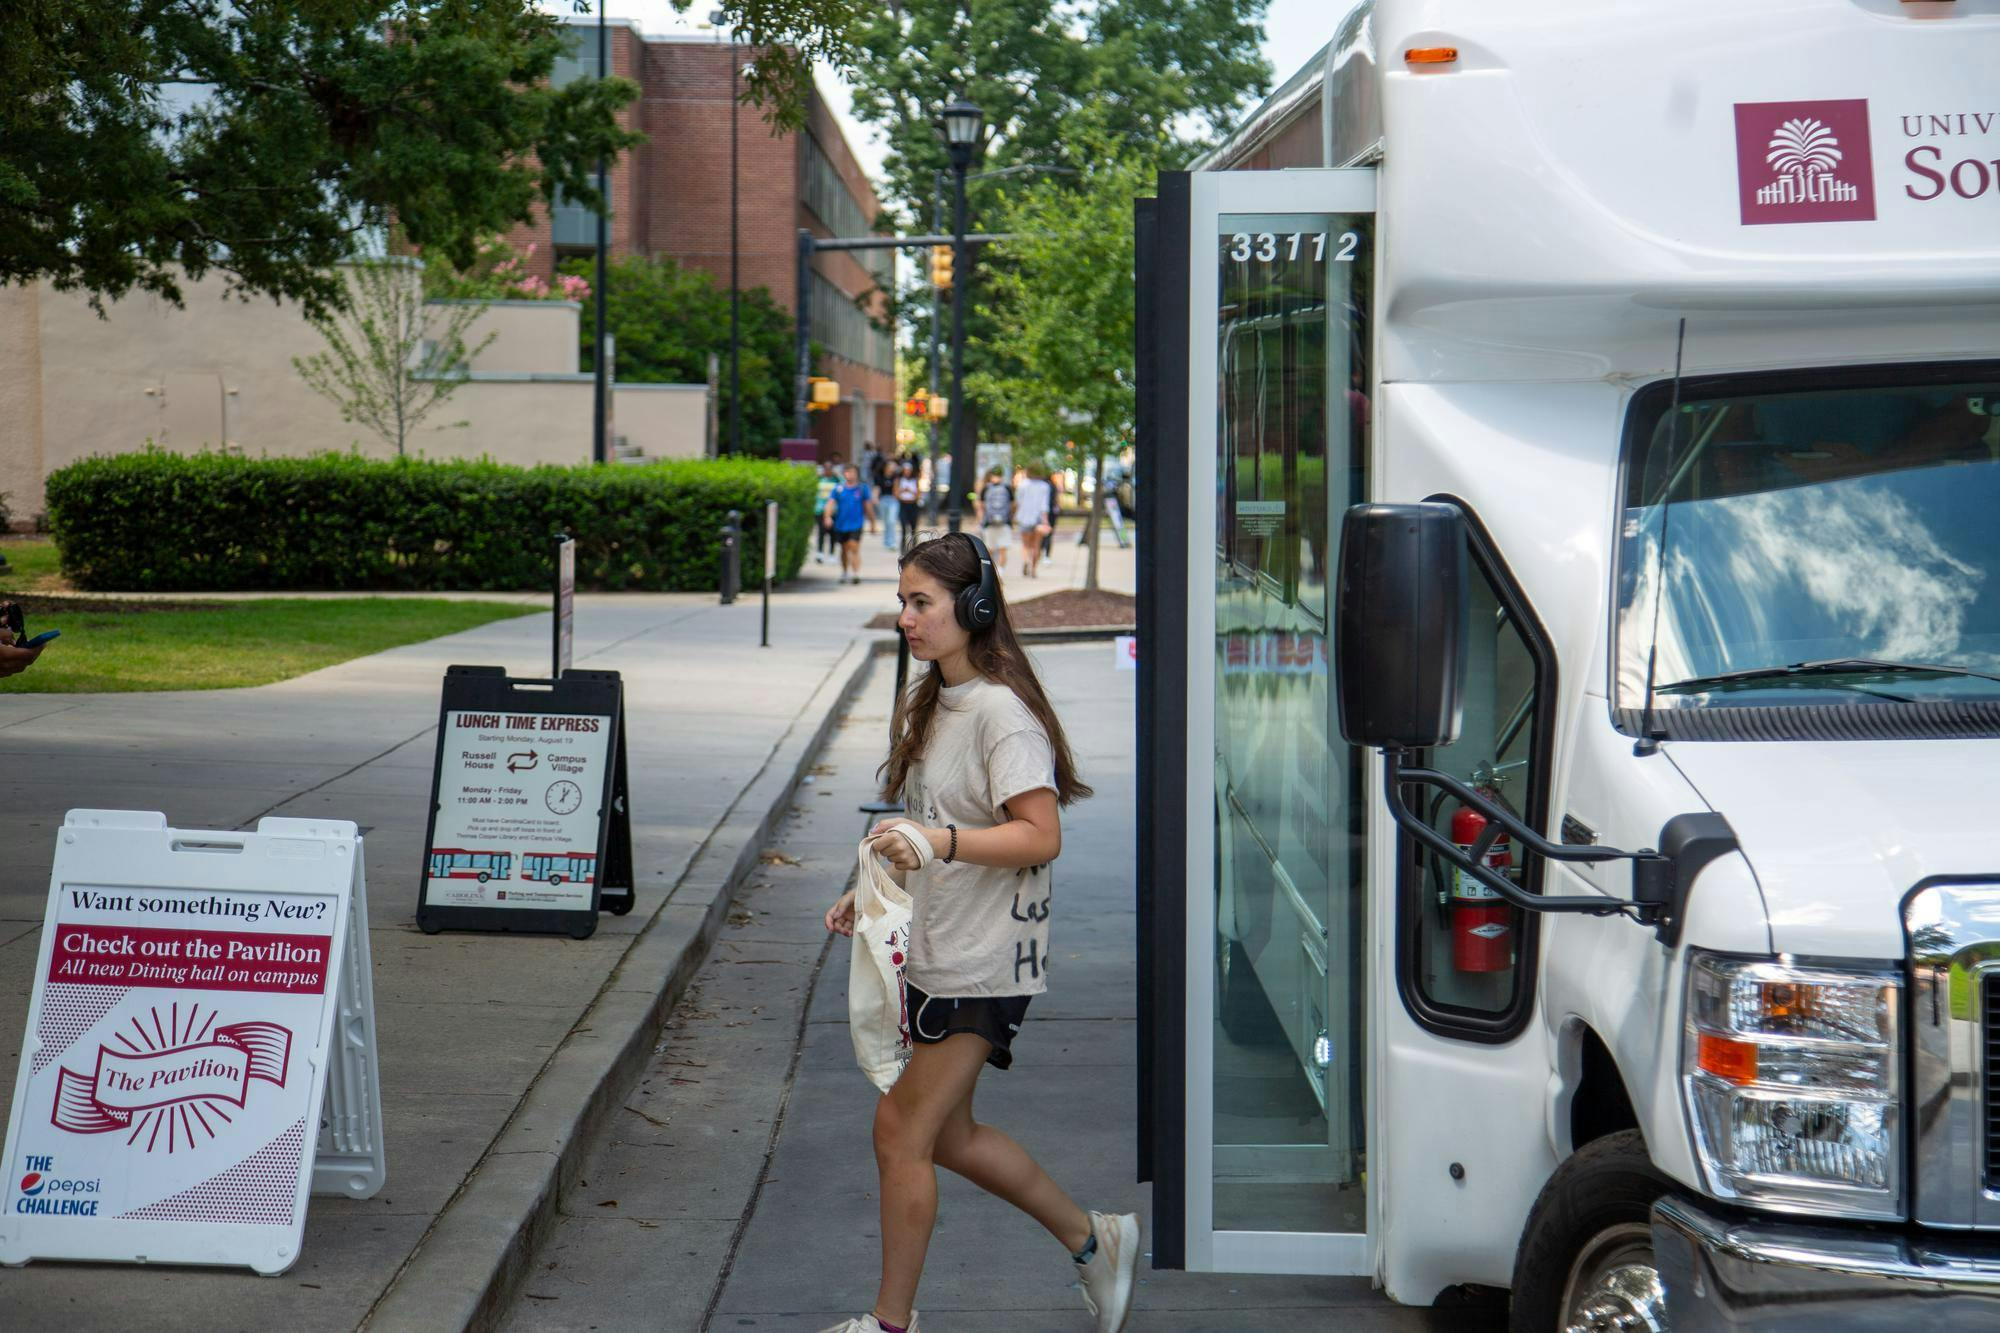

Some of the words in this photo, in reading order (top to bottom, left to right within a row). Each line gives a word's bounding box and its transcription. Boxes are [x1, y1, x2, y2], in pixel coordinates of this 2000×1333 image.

[1901, 112, 2000, 137] UNIV
[1231, 232, 1358, 262] 33112
[456, 714, 500, 728] LUNCH
[505, 715, 537, 730] TIME
[540, 717, 600, 732] EXPRESS
[478, 734, 505, 743] Starting
[538, 736, 563, 744] August
[462, 751, 497, 760] Russell
[547, 754, 587, 764] Campus
[464, 760, 494, 769] House
[551, 763, 584, 774] Village
[462, 786, 492, 795] Monday
[499, 786, 523, 795] Friday
[458, 796, 478, 804] 11:00
[72, 890, 134, 911] Want
[138, 896, 261, 922] something
[264, 900, 326, 920] New?
[63, 933, 137, 955] Check
[140, 940, 181, 957] out
[185, 938, 222, 959] the
[227, 941, 321, 963] Pavilion
[1015, 939, 1048, 983] H
[58, 959, 86, 975] All
[88, 962, 125, 977] new
[128, 962, 188, 983] Dining
[190, 964, 225, 981] hall
[227, 969, 249, 982] on
[253, 970, 319, 988] campus
[106, 1067, 144, 1091] The
[149, 1059, 239, 1088] Pavilion
[26, 1155, 54, 1172] THE
[48, 1178, 101, 1195] pepsi
[16, 1198, 99, 1216] CHALLENGE
